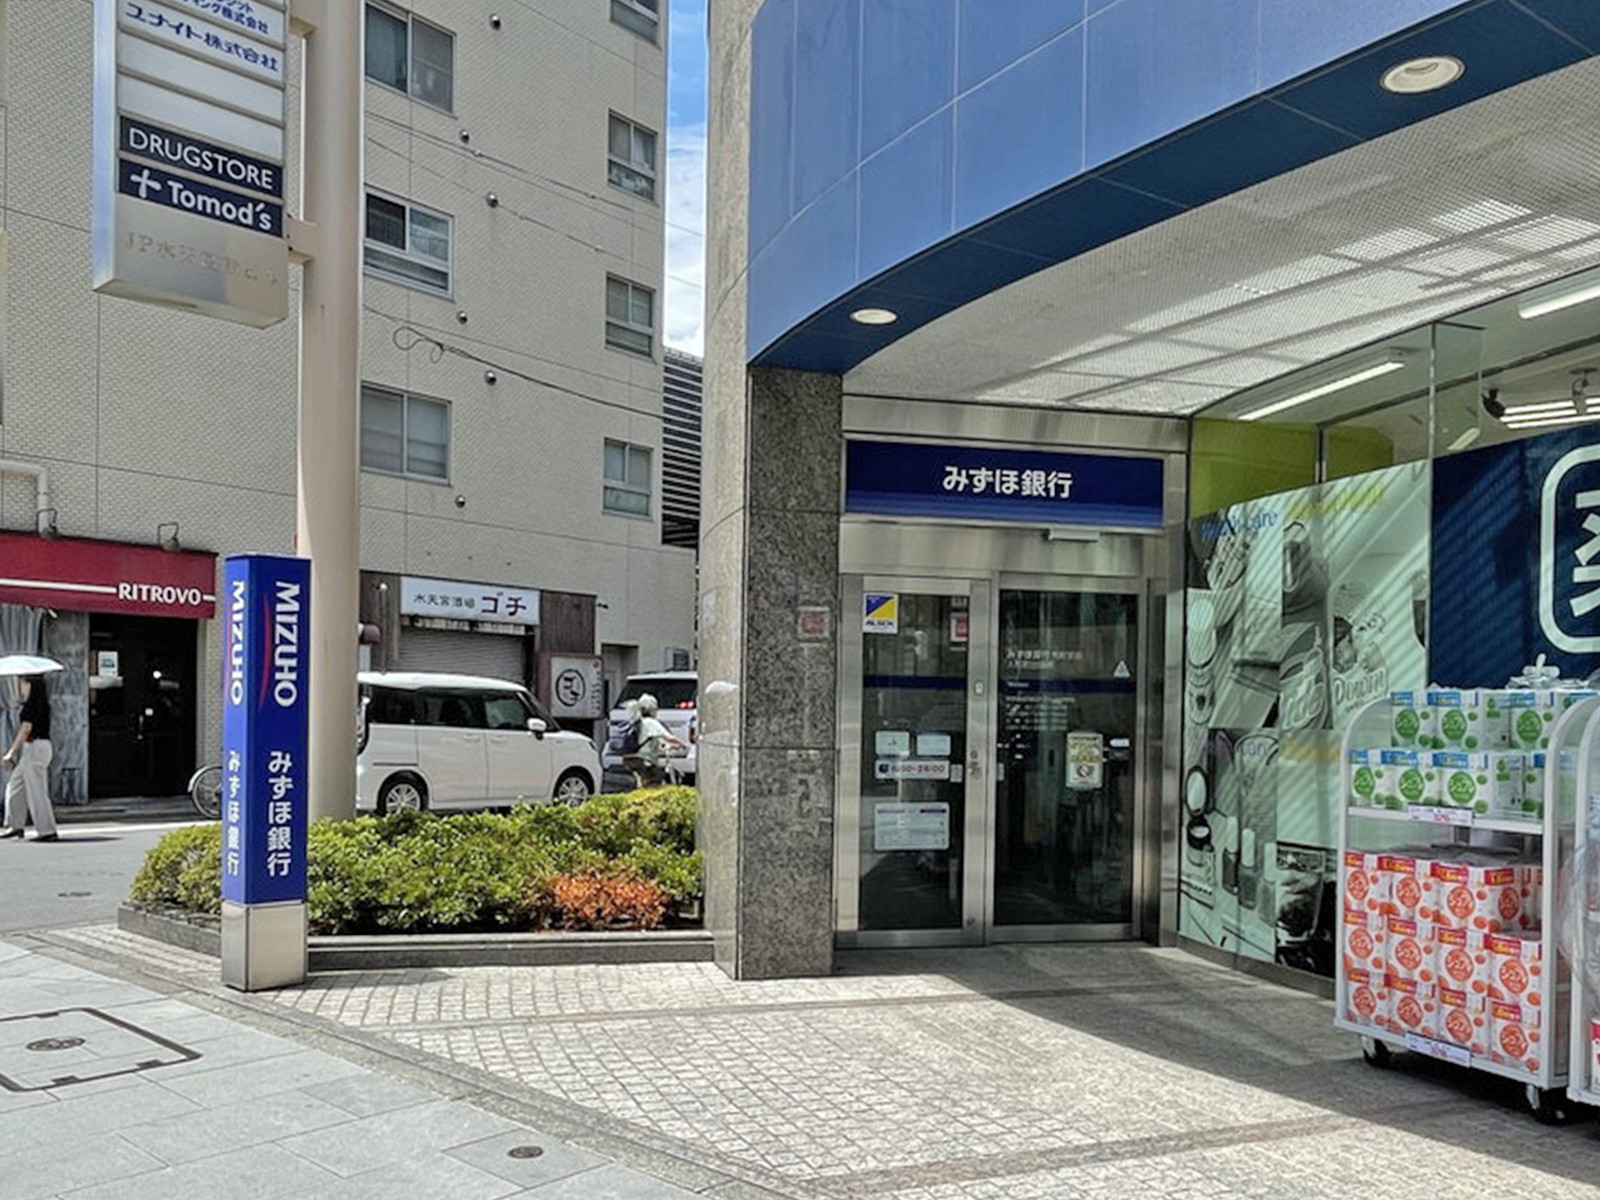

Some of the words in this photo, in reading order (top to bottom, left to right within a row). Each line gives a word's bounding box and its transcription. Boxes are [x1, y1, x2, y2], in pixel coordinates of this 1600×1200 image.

[125, 2, 278, 71] ユナイト株式会社
[129, 127, 273, 190] DRUGSTORE
[167, 180, 272, 230] Tomod's
[942, 465, 1073, 498] みずほ銀行
[118, 582, 201, 606] RITROVO
[481, 591, 527, 616] ゴチ
[231, 581, 244, 705] MIZUHO
[274, 581, 300, 707] MIZUHO
[227, 750, 240, 876] みずほ銀行
[267, 750, 294, 877] みずほ銀行
